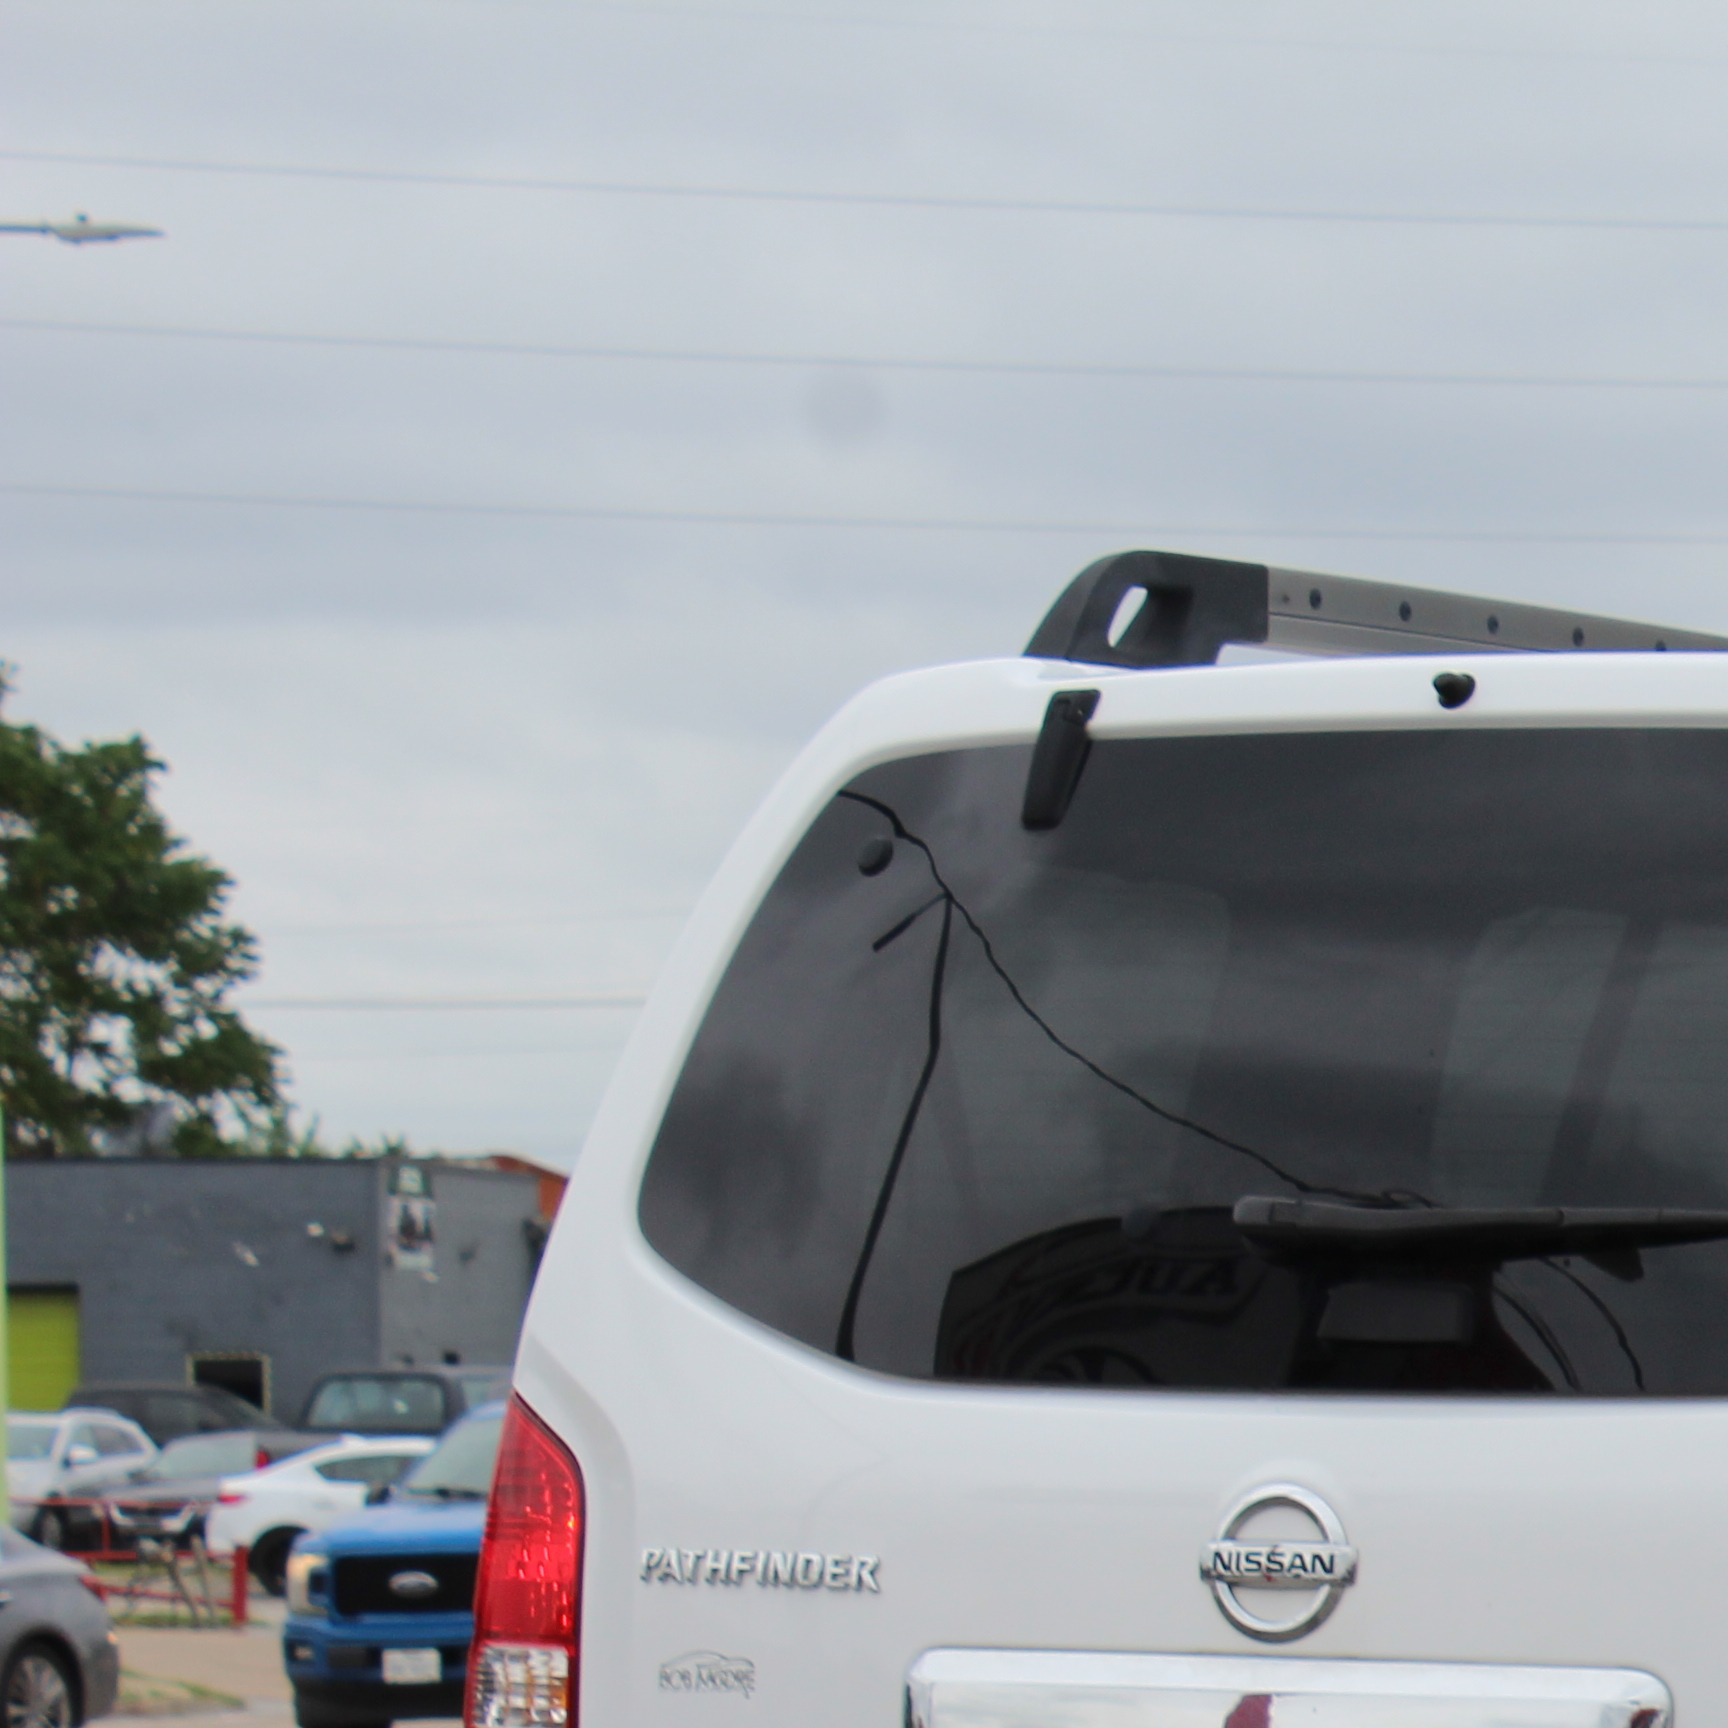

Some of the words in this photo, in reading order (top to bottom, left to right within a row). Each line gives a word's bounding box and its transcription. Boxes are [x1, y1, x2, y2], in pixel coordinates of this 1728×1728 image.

[640, 1547, 881, 1594] PATHFINDER
[1212, 1551, 1335, 1575] NISSAN
[659, 1667, 692, 1692] BOB
[694, 1663, 755, 1699] MOORE
